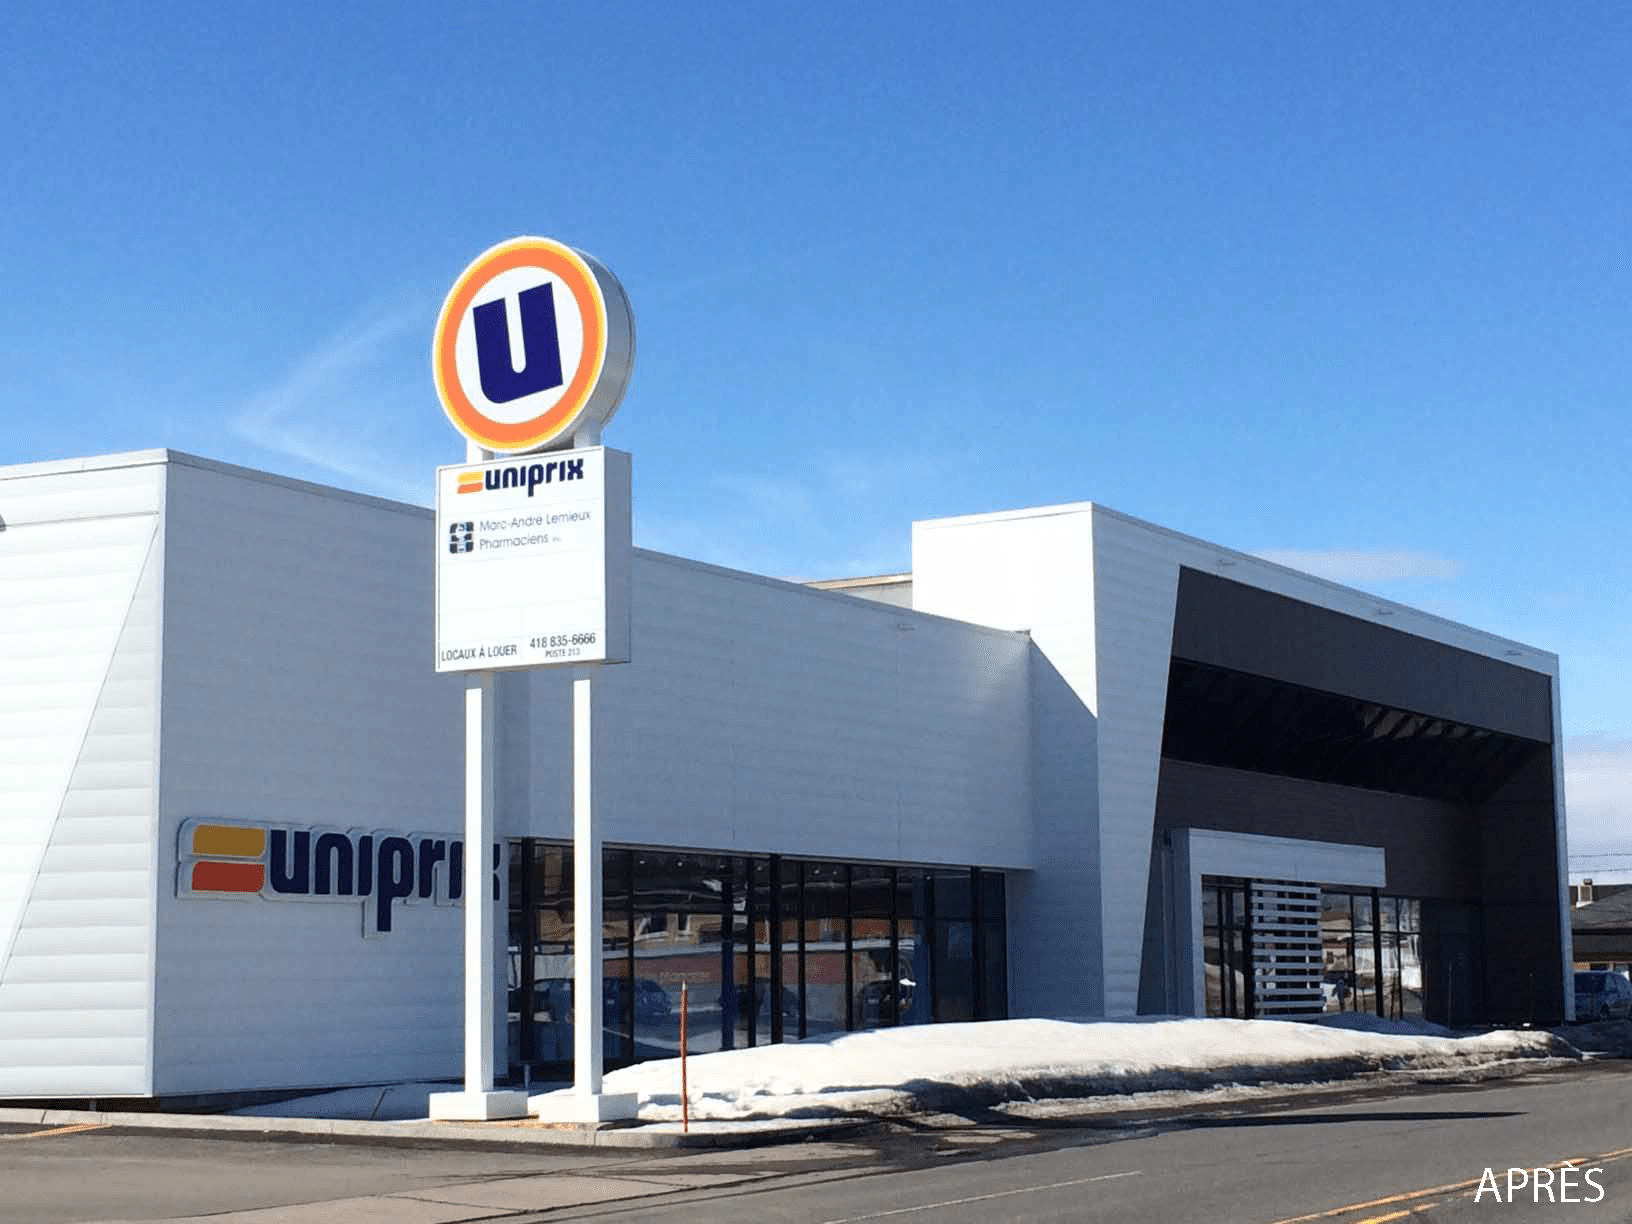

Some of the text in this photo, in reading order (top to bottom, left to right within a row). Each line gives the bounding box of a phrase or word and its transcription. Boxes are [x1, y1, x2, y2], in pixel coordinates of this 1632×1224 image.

[485, 458, 584, 497] uniprix
[546, 511, 592, 525] Lemieux
[480, 534, 549, 550] Pharmaciens
[530, 633, 596, 649] 418 835-6666
[441, 648, 476, 661] LOCAUX
[488, 645, 517, 658] LOUER
[270, 829, 500, 932] unipri
